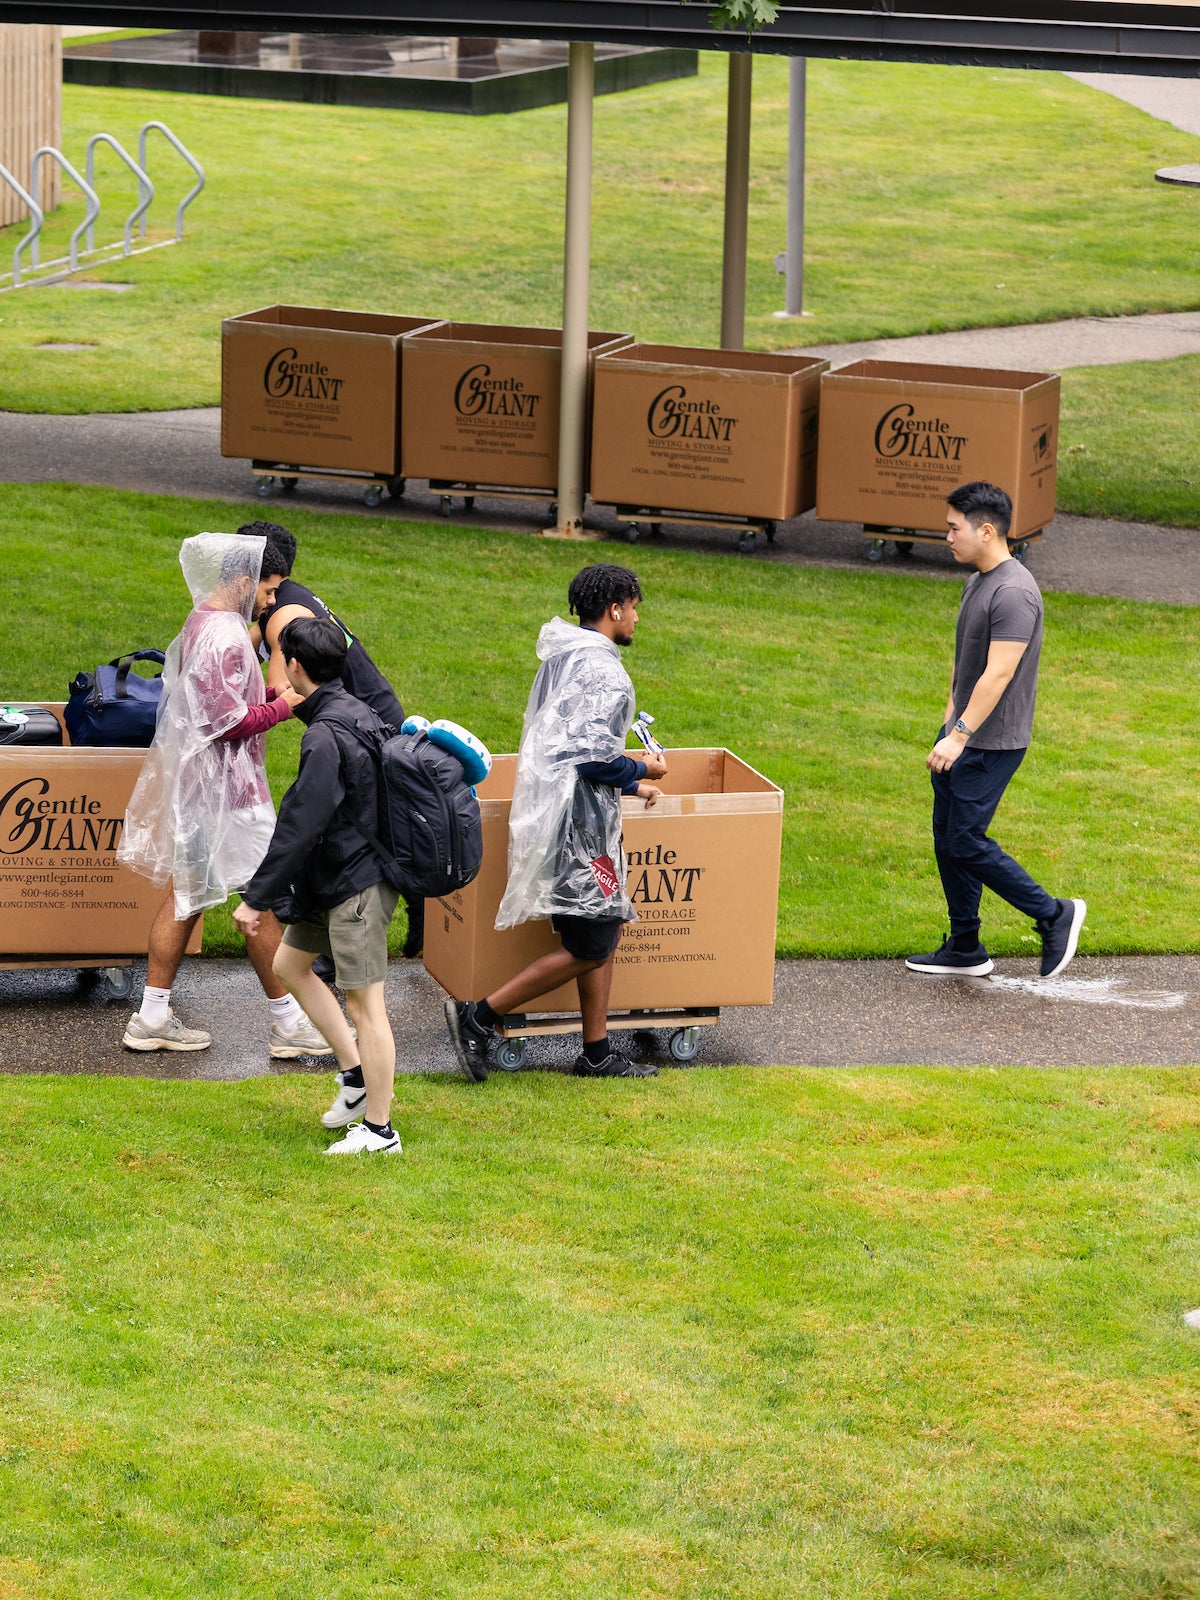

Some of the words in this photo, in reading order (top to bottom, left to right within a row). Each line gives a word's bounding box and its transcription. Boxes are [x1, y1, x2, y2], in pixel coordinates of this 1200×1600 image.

[264, 347, 343, 401] GIANT
[454, 364, 540, 417] GIANT
[647, 385, 737, 441] GIANT
[455, 416, 489, 425] MOVING
[499, 419, 537, 428] STORAGE
[874, 403, 966, 460] GIANT
[648, 438, 682, 448] MOVING
[693, 442, 732, 452] STORAGE
[875, 457, 911, 467] MOVING
[922, 462, 962, 471] STORAGE
[48, 858, 55, 866] &
[60, 857, 119, 867] STORAGE
[627, 844, 677, 866] ntle
[21, 888, 84, 898] 800-466-8844
[0, 901, 23, 909] LONG
[24, 901, 65, 909] DISTANCE
[71, 901, 138, 910] INTERNATIONAL
[637, 908, 696, 920] STORAGE
[622, 926, 690, 940] tlegiant.com
[615, 943, 661, 952] -466-8844
[648, 953, 716, 963] INTERNATIONAL
